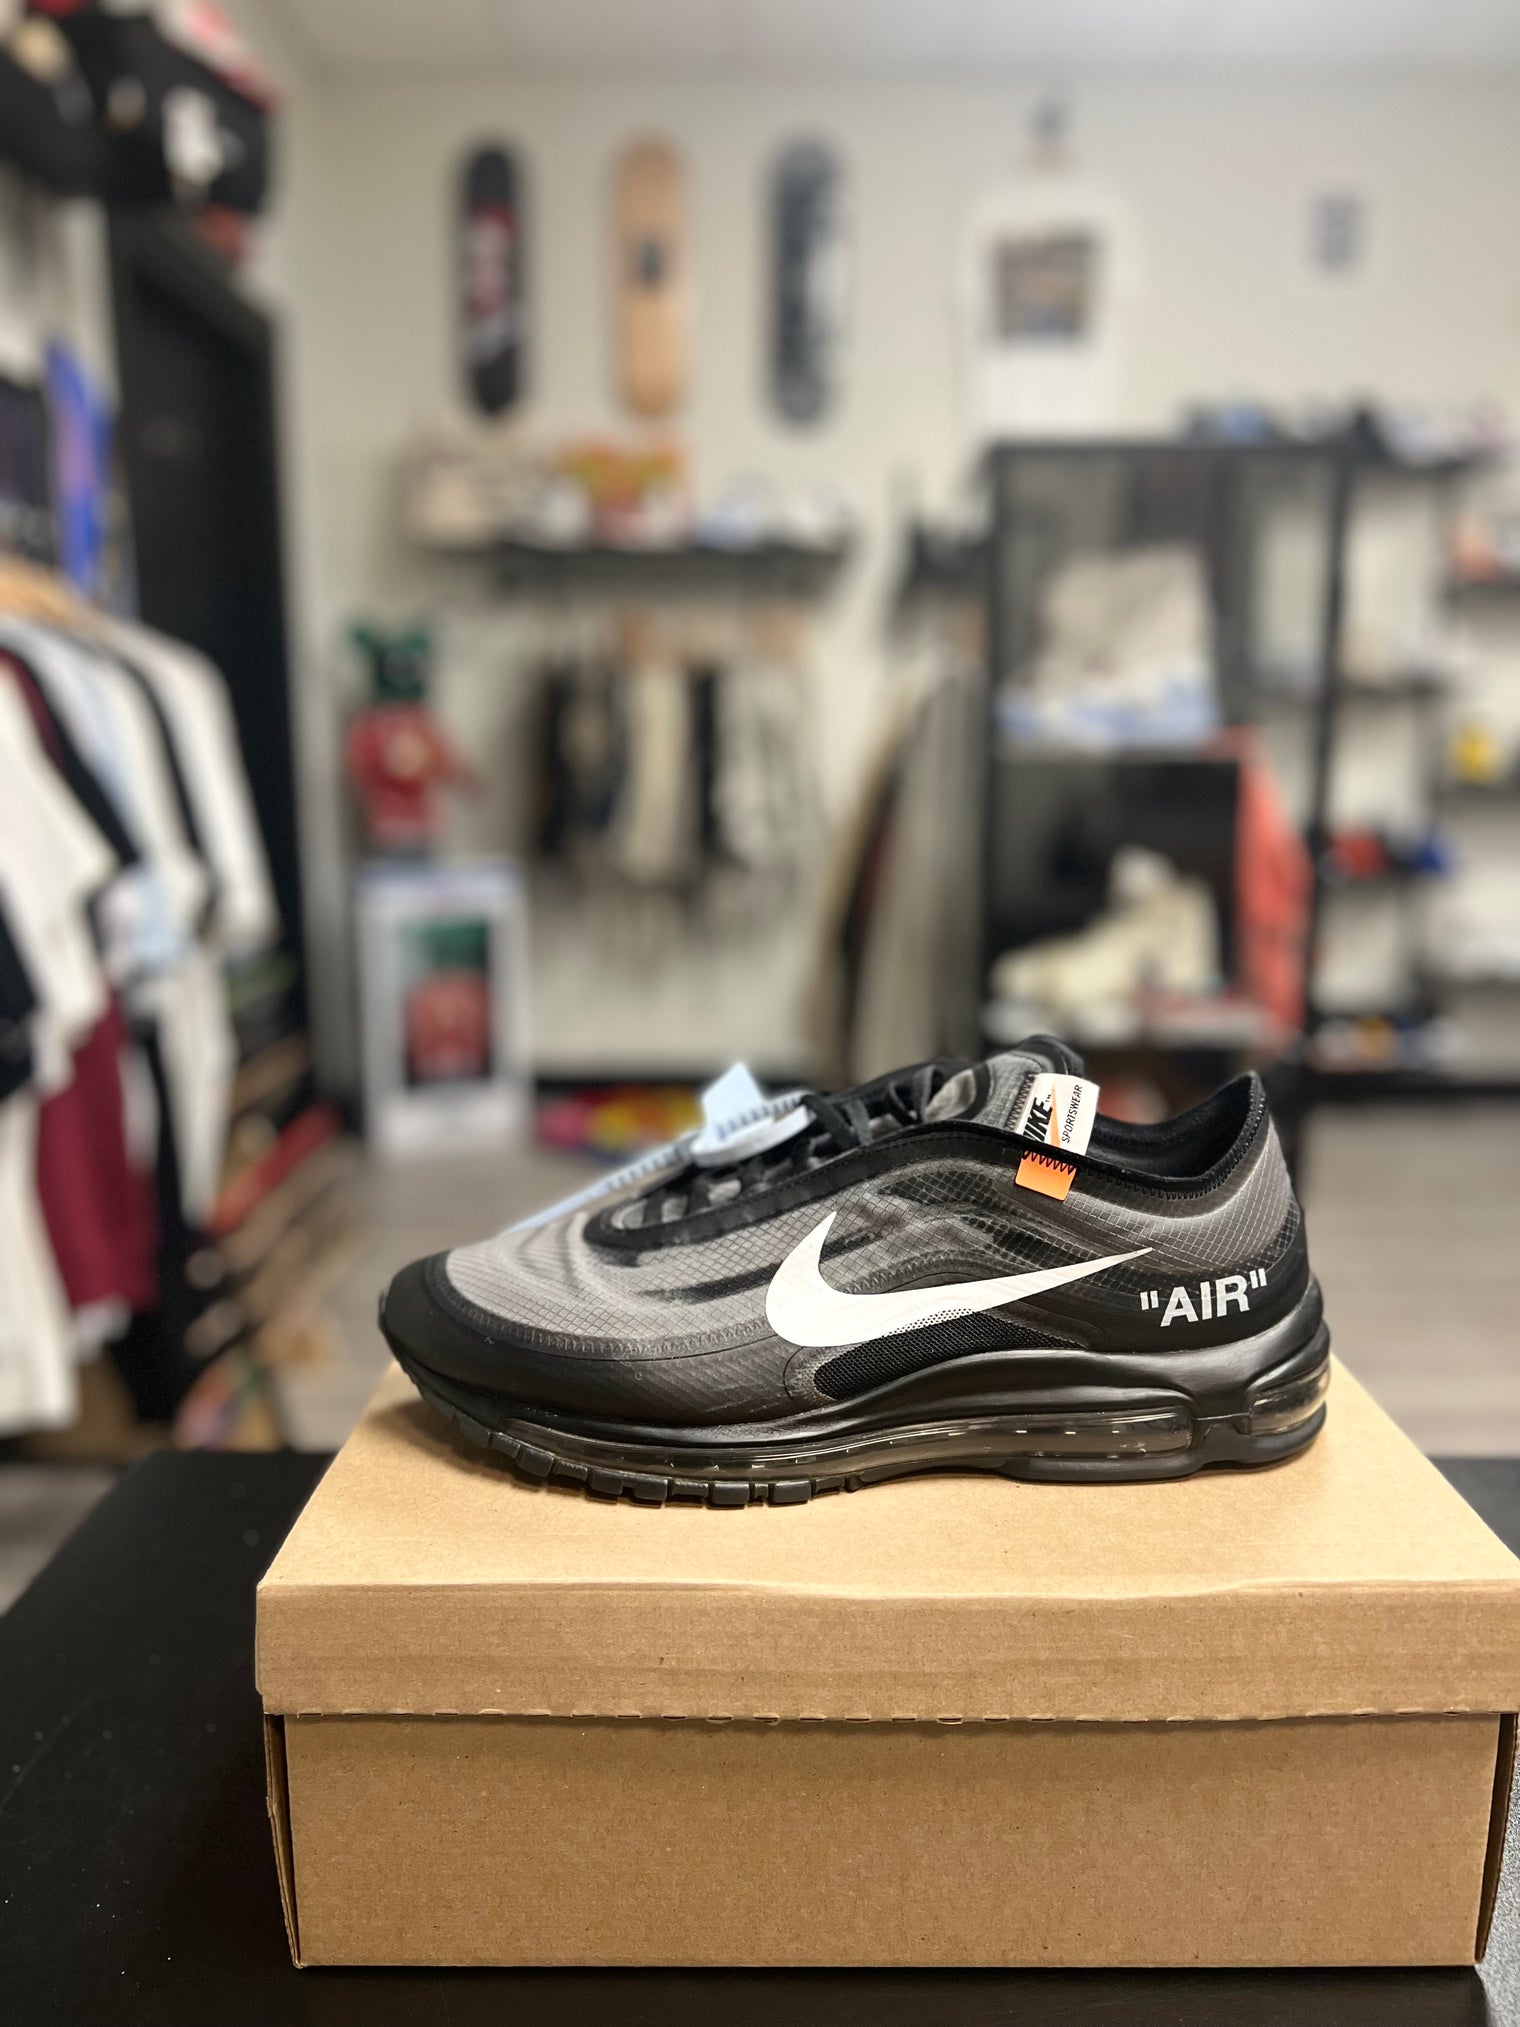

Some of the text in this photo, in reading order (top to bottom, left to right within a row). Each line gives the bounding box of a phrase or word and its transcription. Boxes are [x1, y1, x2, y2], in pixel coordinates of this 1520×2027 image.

[1023, 1097, 1053, 1142] IKE
[1061, 1084, 1083, 1143] SPORTSWEAR
[1140, 1268, 1267, 1327] "AIR"
